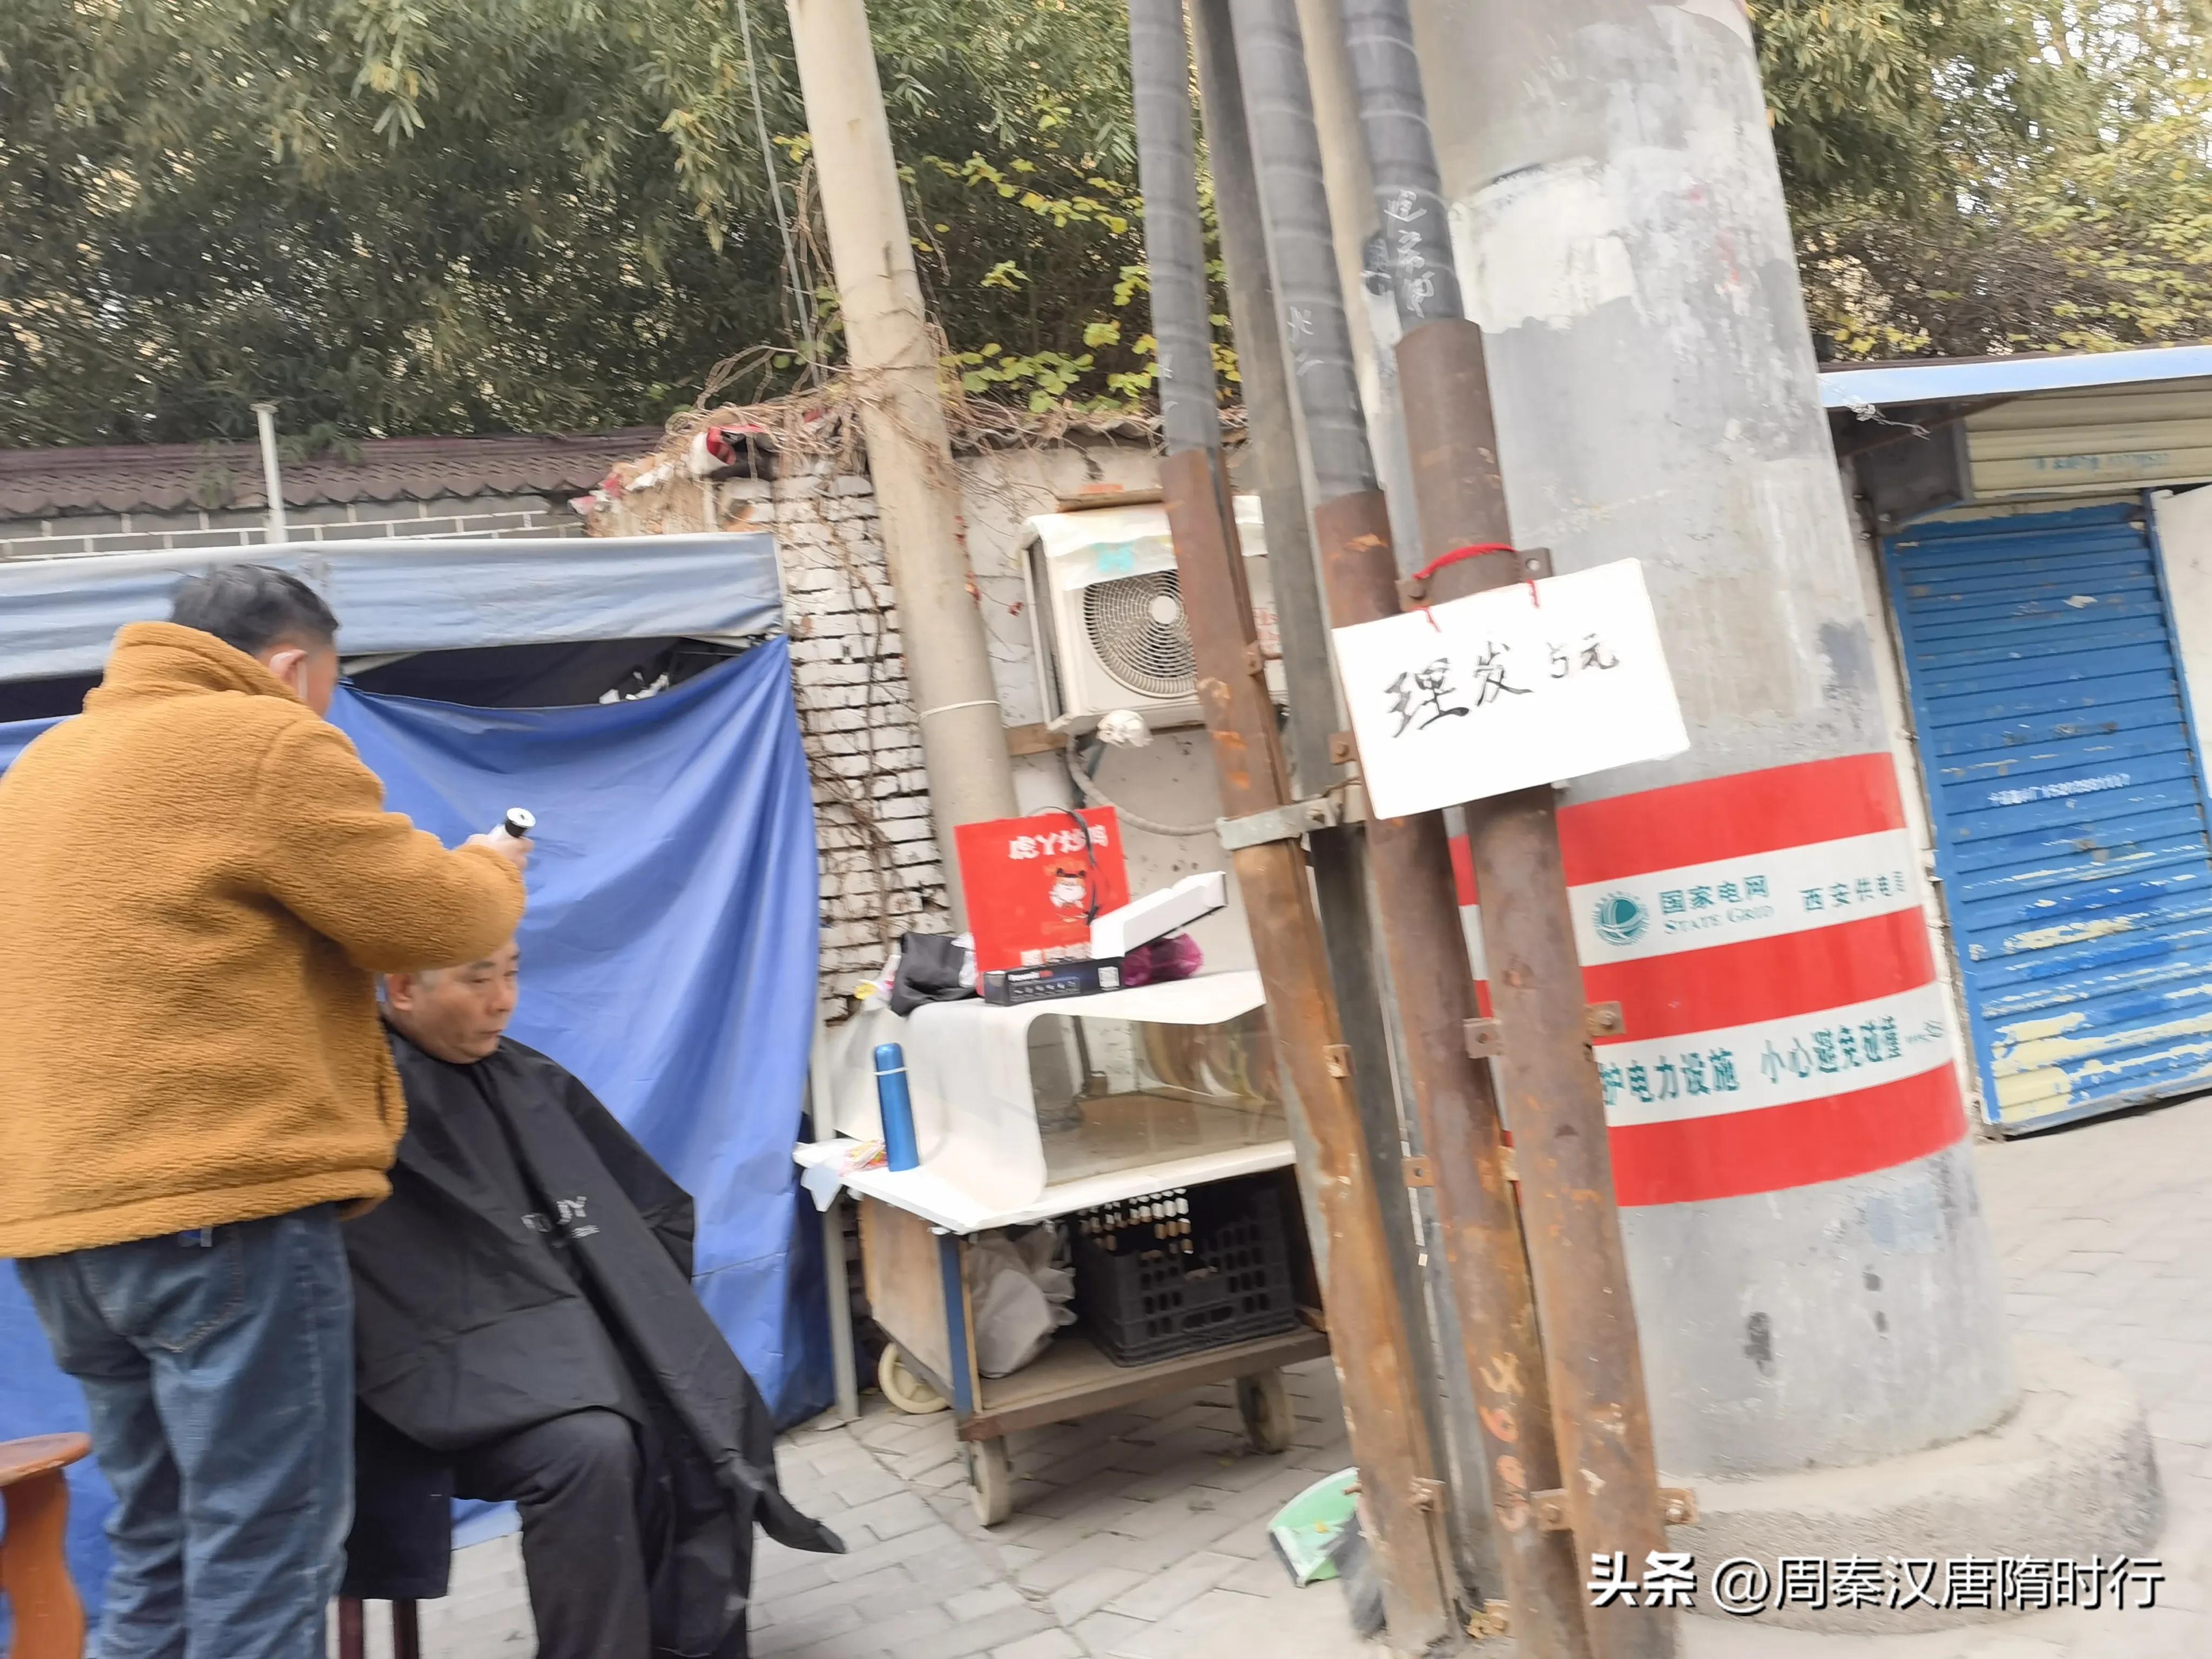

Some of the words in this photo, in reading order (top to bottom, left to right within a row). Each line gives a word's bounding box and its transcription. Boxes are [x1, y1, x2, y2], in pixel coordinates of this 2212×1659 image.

[1384, 640, 1534, 738] 理发
[1546, 632, 1620, 679] 5元
[1658, 874, 1770, 915] 国家电网
